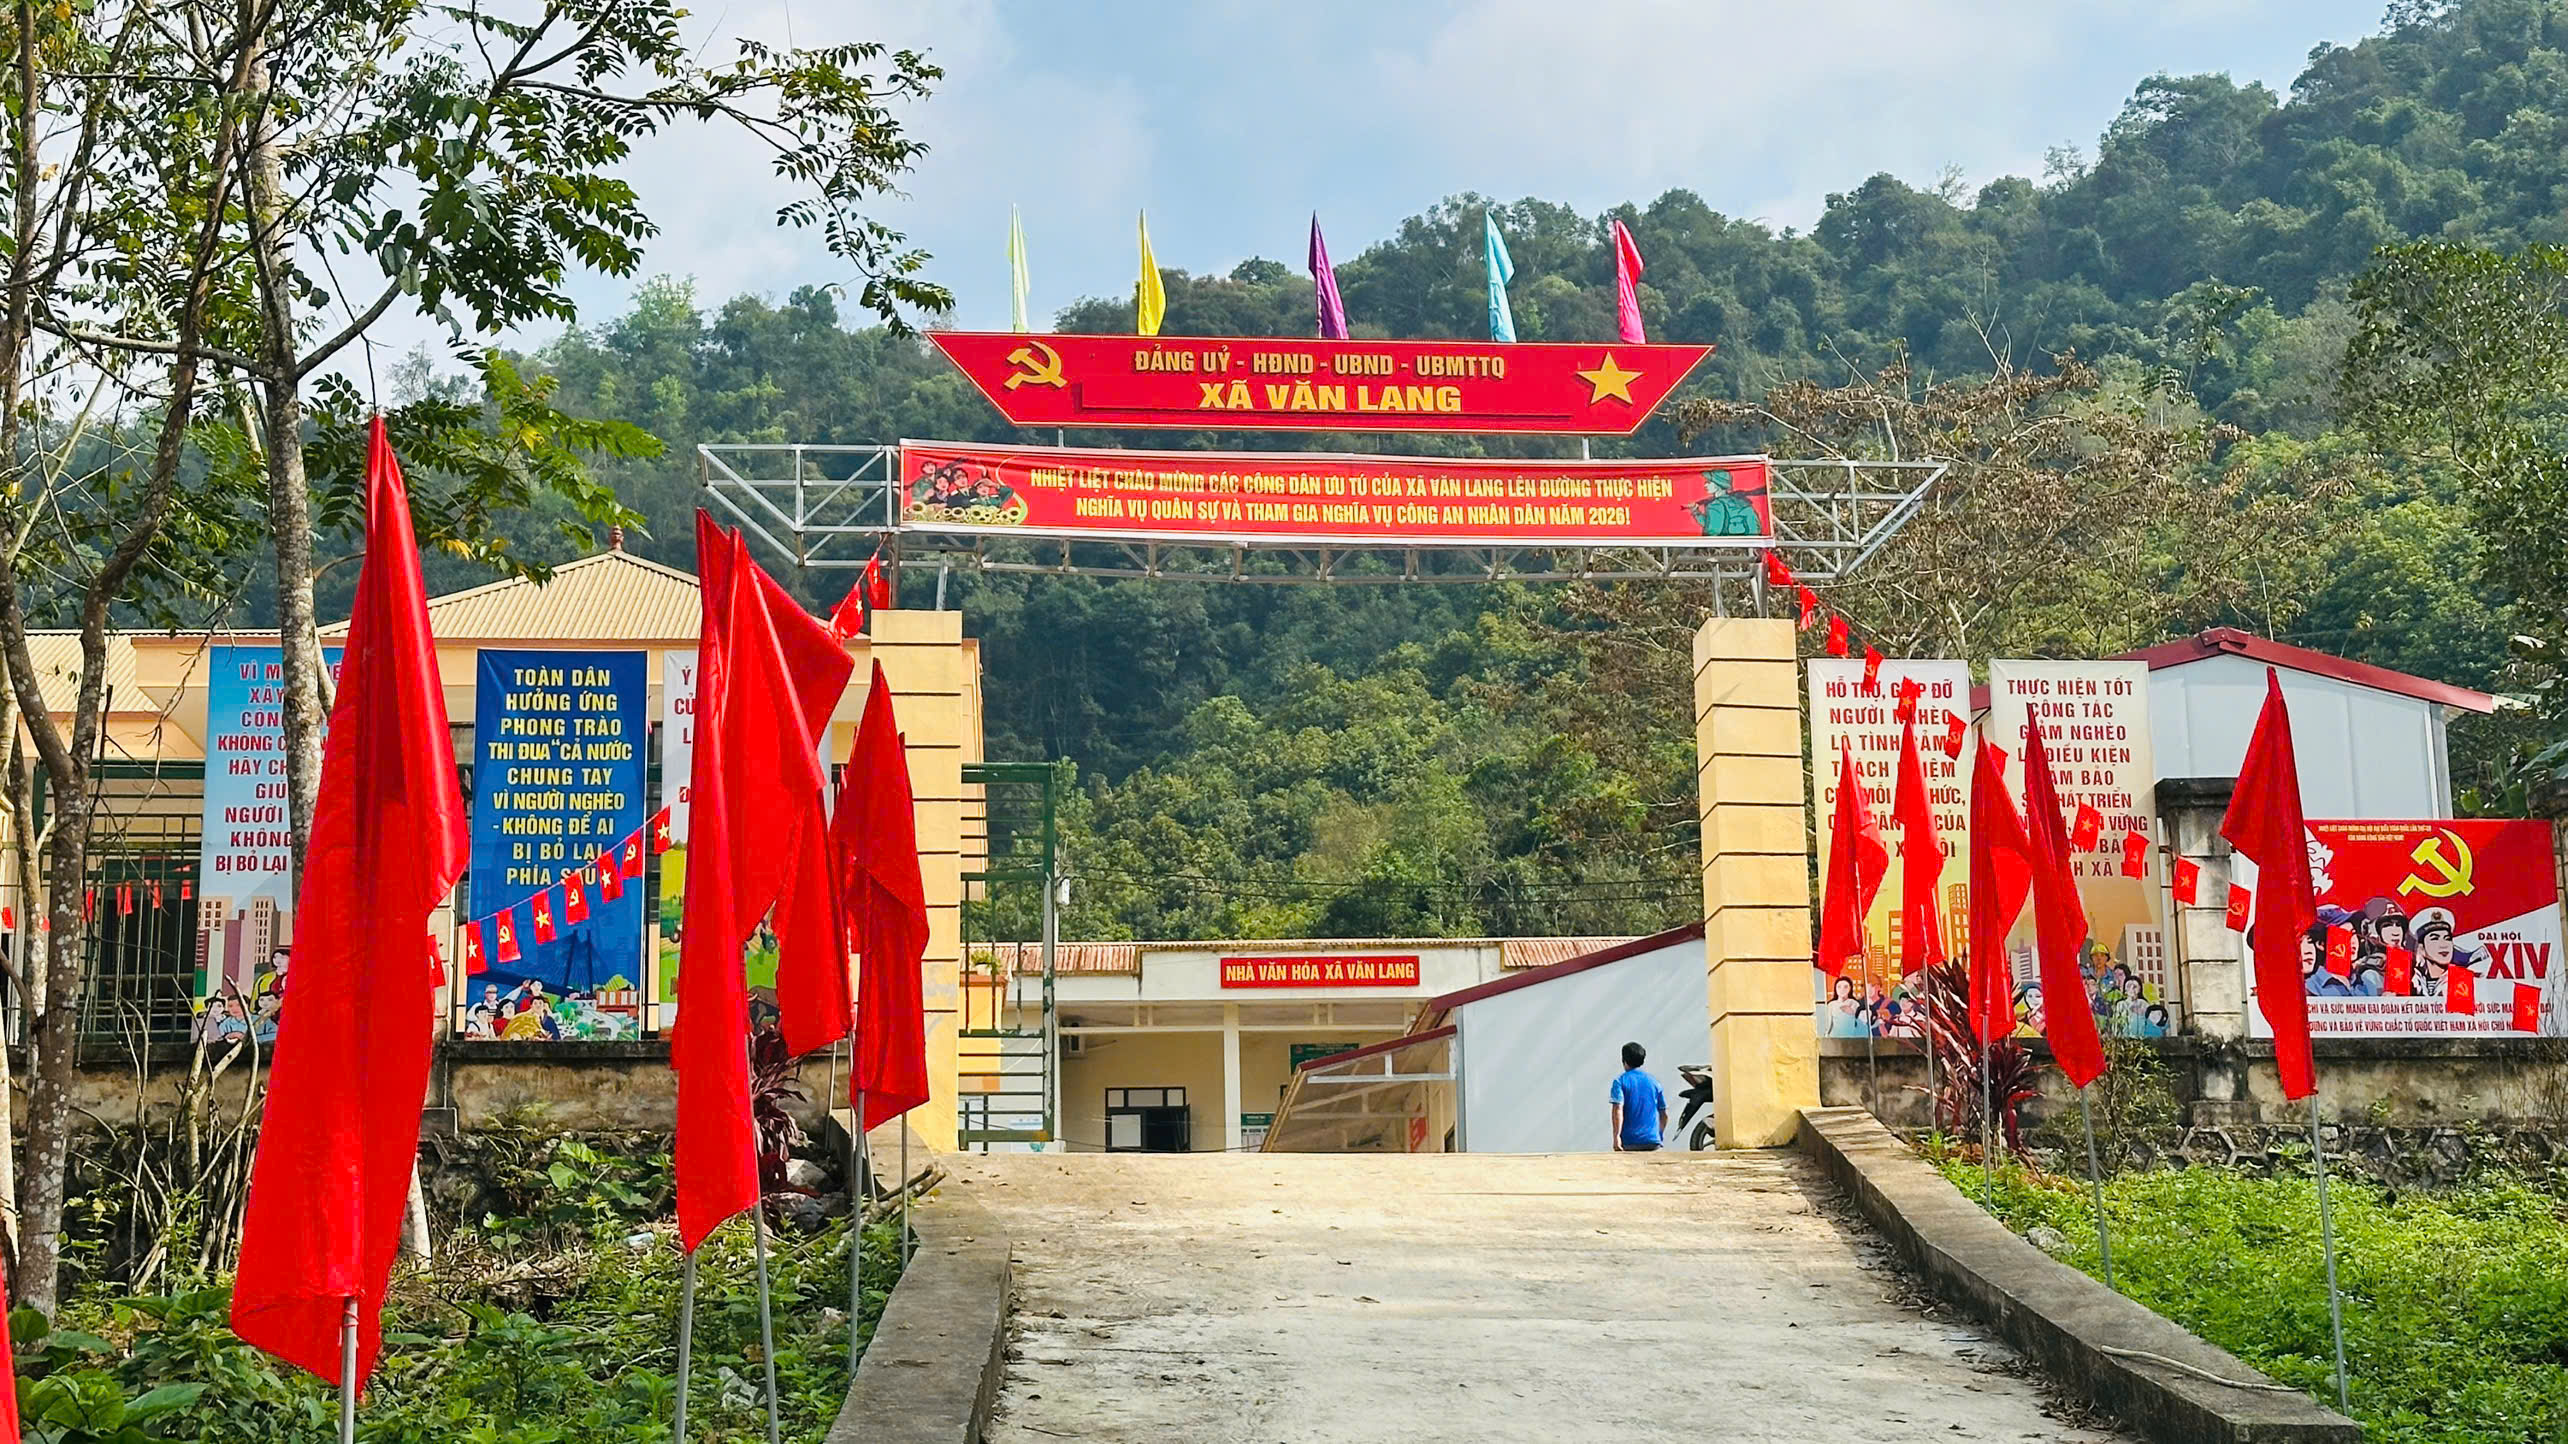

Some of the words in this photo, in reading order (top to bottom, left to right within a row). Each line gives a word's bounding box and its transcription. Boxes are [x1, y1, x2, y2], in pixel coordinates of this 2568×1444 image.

[1135, 345, 1194, 372] ĐẢNG
[1203, 346, 1230, 372] UỶ
[1253, 353, 1315, 375] HĐND
[1334, 354, 1394, 376] UBND
[1416, 355, 1505, 380] UBMTTQ
[1200, 379, 1253, 409] XÃ
[1265, 380, 1347, 411] VĂN
[1358, 385, 1462, 412] LANG
[1031, 469, 1074, 491] NHIỆT
[1079, 470, 1109, 493] LIỆT
[1113, 469, 1155, 491] CHÀO
[1159, 470, 1205, 493] MỪNG
[1209, 471, 1239, 494] CÁC
[1243, 472, 1285, 495] CÔNG
[1289, 472, 1322, 495] DÂN
[1325, 476, 1346, 496] ƯU
[1349, 474, 1368, 496] TÚ
[1371, 472, 1402, 496] CỦA
[1406, 474, 1427, 497] XÃ
[1430, 475, 1461, 497] VĂN
[1464, 478, 1504, 497] LANG
[1508, 475, 1536, 498] LÊN
[1539, 474, 1591, 498] ĐƯỜNG
[1594, 478, 1633, 501] THỰC
[1637, 475, 1673, 501] HIỆN
[1076, 495, 1124, 517] NGHĨA
[1127, 499, 1148, 523] VỤ
[1151, 497, 1194, 520] QUÂN
[1197, 498, 1220, 524] SỰ
[1222, 498, 1243, 521] VÀ
[1246, 503, 1289, 522] THAM
[1292, 503, 1319, 522] GIA
[1323, 501, 1369, 524] NGHĨA
[1372, 505, 1393, 528] VỤ
[1396, 502, 1438, 525] CÔNG
[1441, 506, 1465, 526] AN
[1467, 502, 1511, 526] NHÂN
[1513, 502, 1546, 526] DÂN
[1549, 502, 1585, 526] NĂM
[1589, 506, 1631, 526] 2026!
[240, 660, 257, 681] VÌ
[514, 665, 564, 686] TOÀN
[571, 665, 611, 686] DÂN
[1826, 676, 1847, 698] HỖ
[1931, 679, 1953, 699] ĐỠ
[2007, 678, 2049, 698] THỰC
[2057, 677, 2096, 699] HIỆN
[2104, 675, 2133, 695] TỐT
[505, 688, 571, 711] HƯỞNG
[579, 690, 618, 711] ỨNG
[2030, 699, 2075, 718] CÔNG
[2082, 700, 2113, 718] TÁC
[241, 709, 285, 732] CỘN
[1830, 704, 1884, 725] NGƯỜI
[500, 718, 566, 736] PHONG
[573, 714, 622, 737] TRÀO
[2071, 722, 2126, 740] NGHÈO
[218, 732, 272, 752] KHÔNG
[488, 742, 514, 760] THI
[586, 740, 633, 761] NƯỚC
[1859, 731, 1900, 751] TÌNH
[2091, 745, 2130, 766] KIỆN
[507, 768, 573, 786] CHUNG
[582, 768, 613, 786] TAY
[1832, 757, 1889, 777] TÁCH
[2081, 765, 2114, 785] BẢO
[255, 781, 287, 799] GIÚ
[493, 788, 510, 810] VÌ
[513, 789, 565, 811] NGƯỜI
[569, 788, 625, 811] NGHÈO
[2089, 787, 2132, 808] TRIỂN
[225, 803, 283, 823] NGƯỜI
[568, 811, 591, 836] ĐỂ
[597, 818, 614, 835] AI
[2109, 813, 2148, 831] VỮNG
[512, 843, 532, 865] BỊ
[540, 837, 565, 860] BỎ
[573, 843, 603, 864] LẠI
[215, 855, 231, 876] BỊ
[236, 851, 258, 872] BỎ
[263, 855, 287, 876] LẠI
[2092, 858, 2113, 877] XÃ
[506, 864, 552, 885] PHÍA
[1226, 962, 1255, 982] NHÀ
[1258, 962, 1287, 981] VĂN
[1292, 961, 1320, 981] HÓA
[1324, 960, 1344, 980] XÃ
[1347, 961, 1375, 980] VĂN
[1379, 963, 1415, 979] LANG
[2484, 943, 2551, 979] XIV
